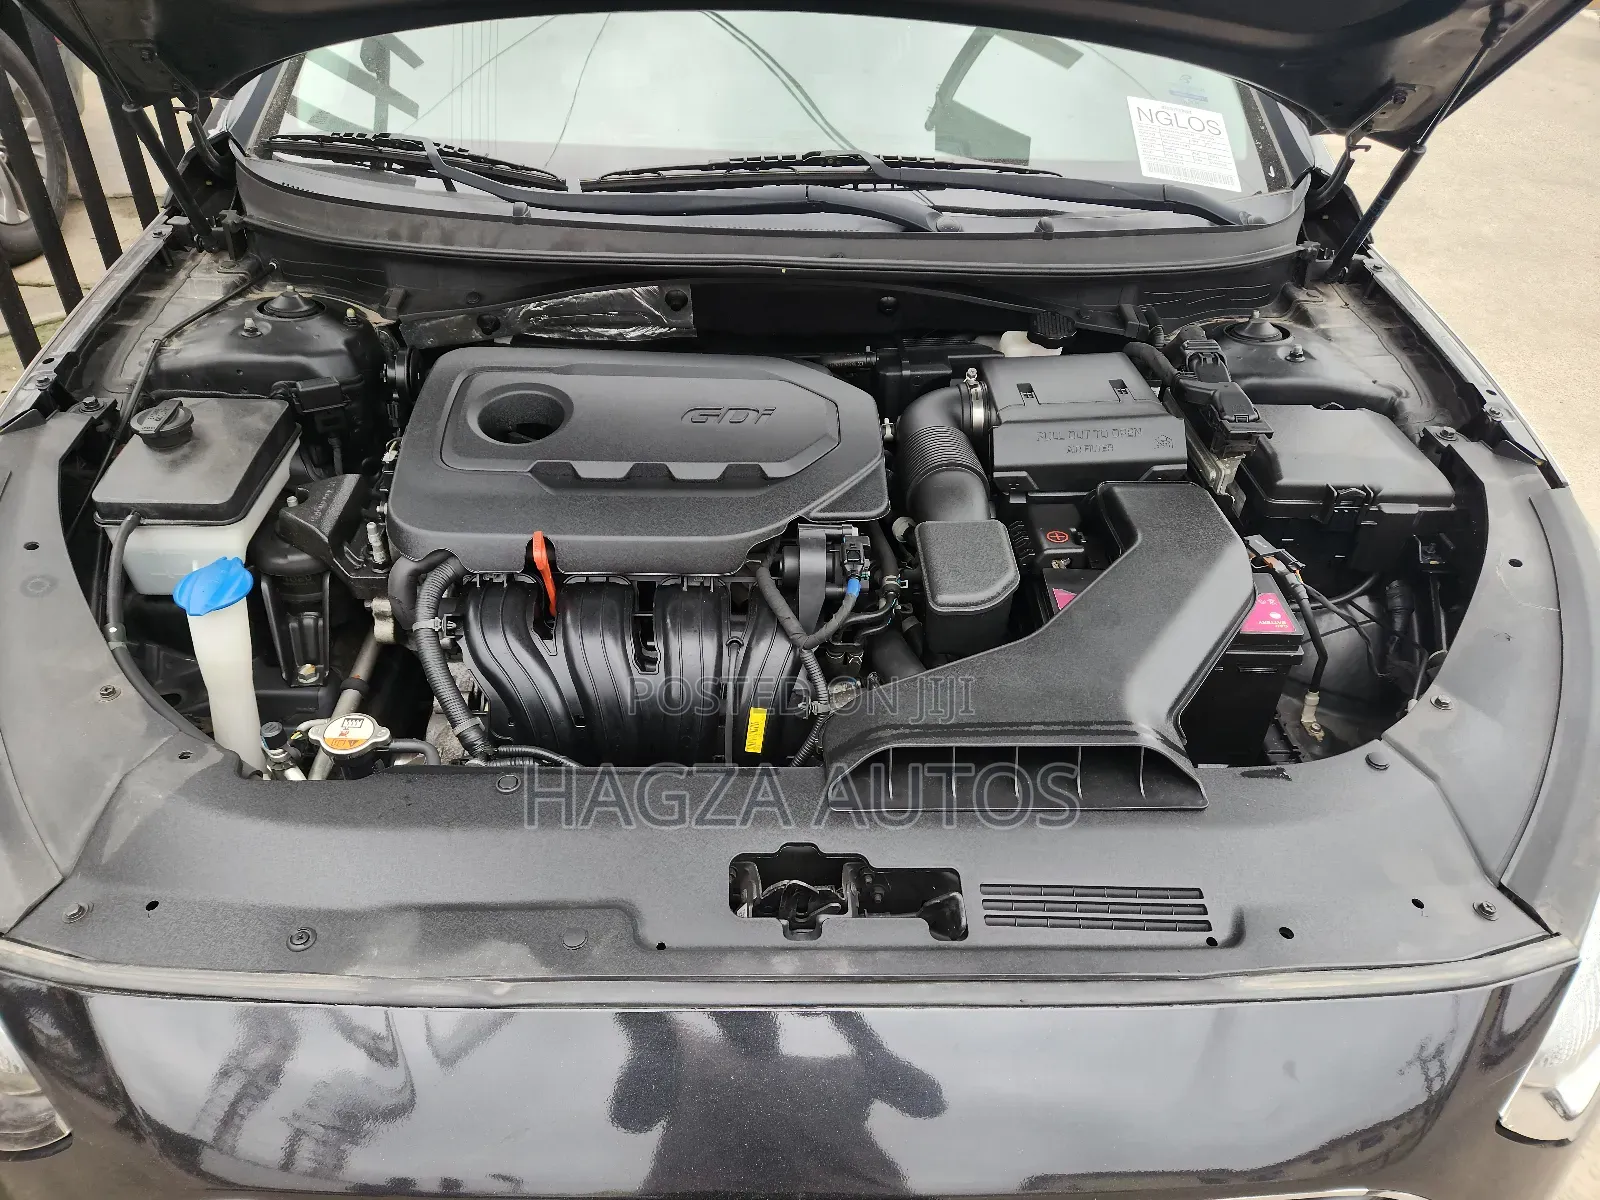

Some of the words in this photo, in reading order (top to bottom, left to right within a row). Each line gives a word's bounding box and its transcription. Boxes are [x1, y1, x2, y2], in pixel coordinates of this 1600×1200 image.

[1136, 106, 1222, 136] NGLOS
[1036, 430, 1064, 441] PULL
[1068, 429, 1090, 440] OUT
[1092, 428, 1109, 439] TO
[1111, 427, 1142, 438] OPEN
[1066, 444, 1082, 454] AIR
[1084, 443, 1114, 453] FILTER
